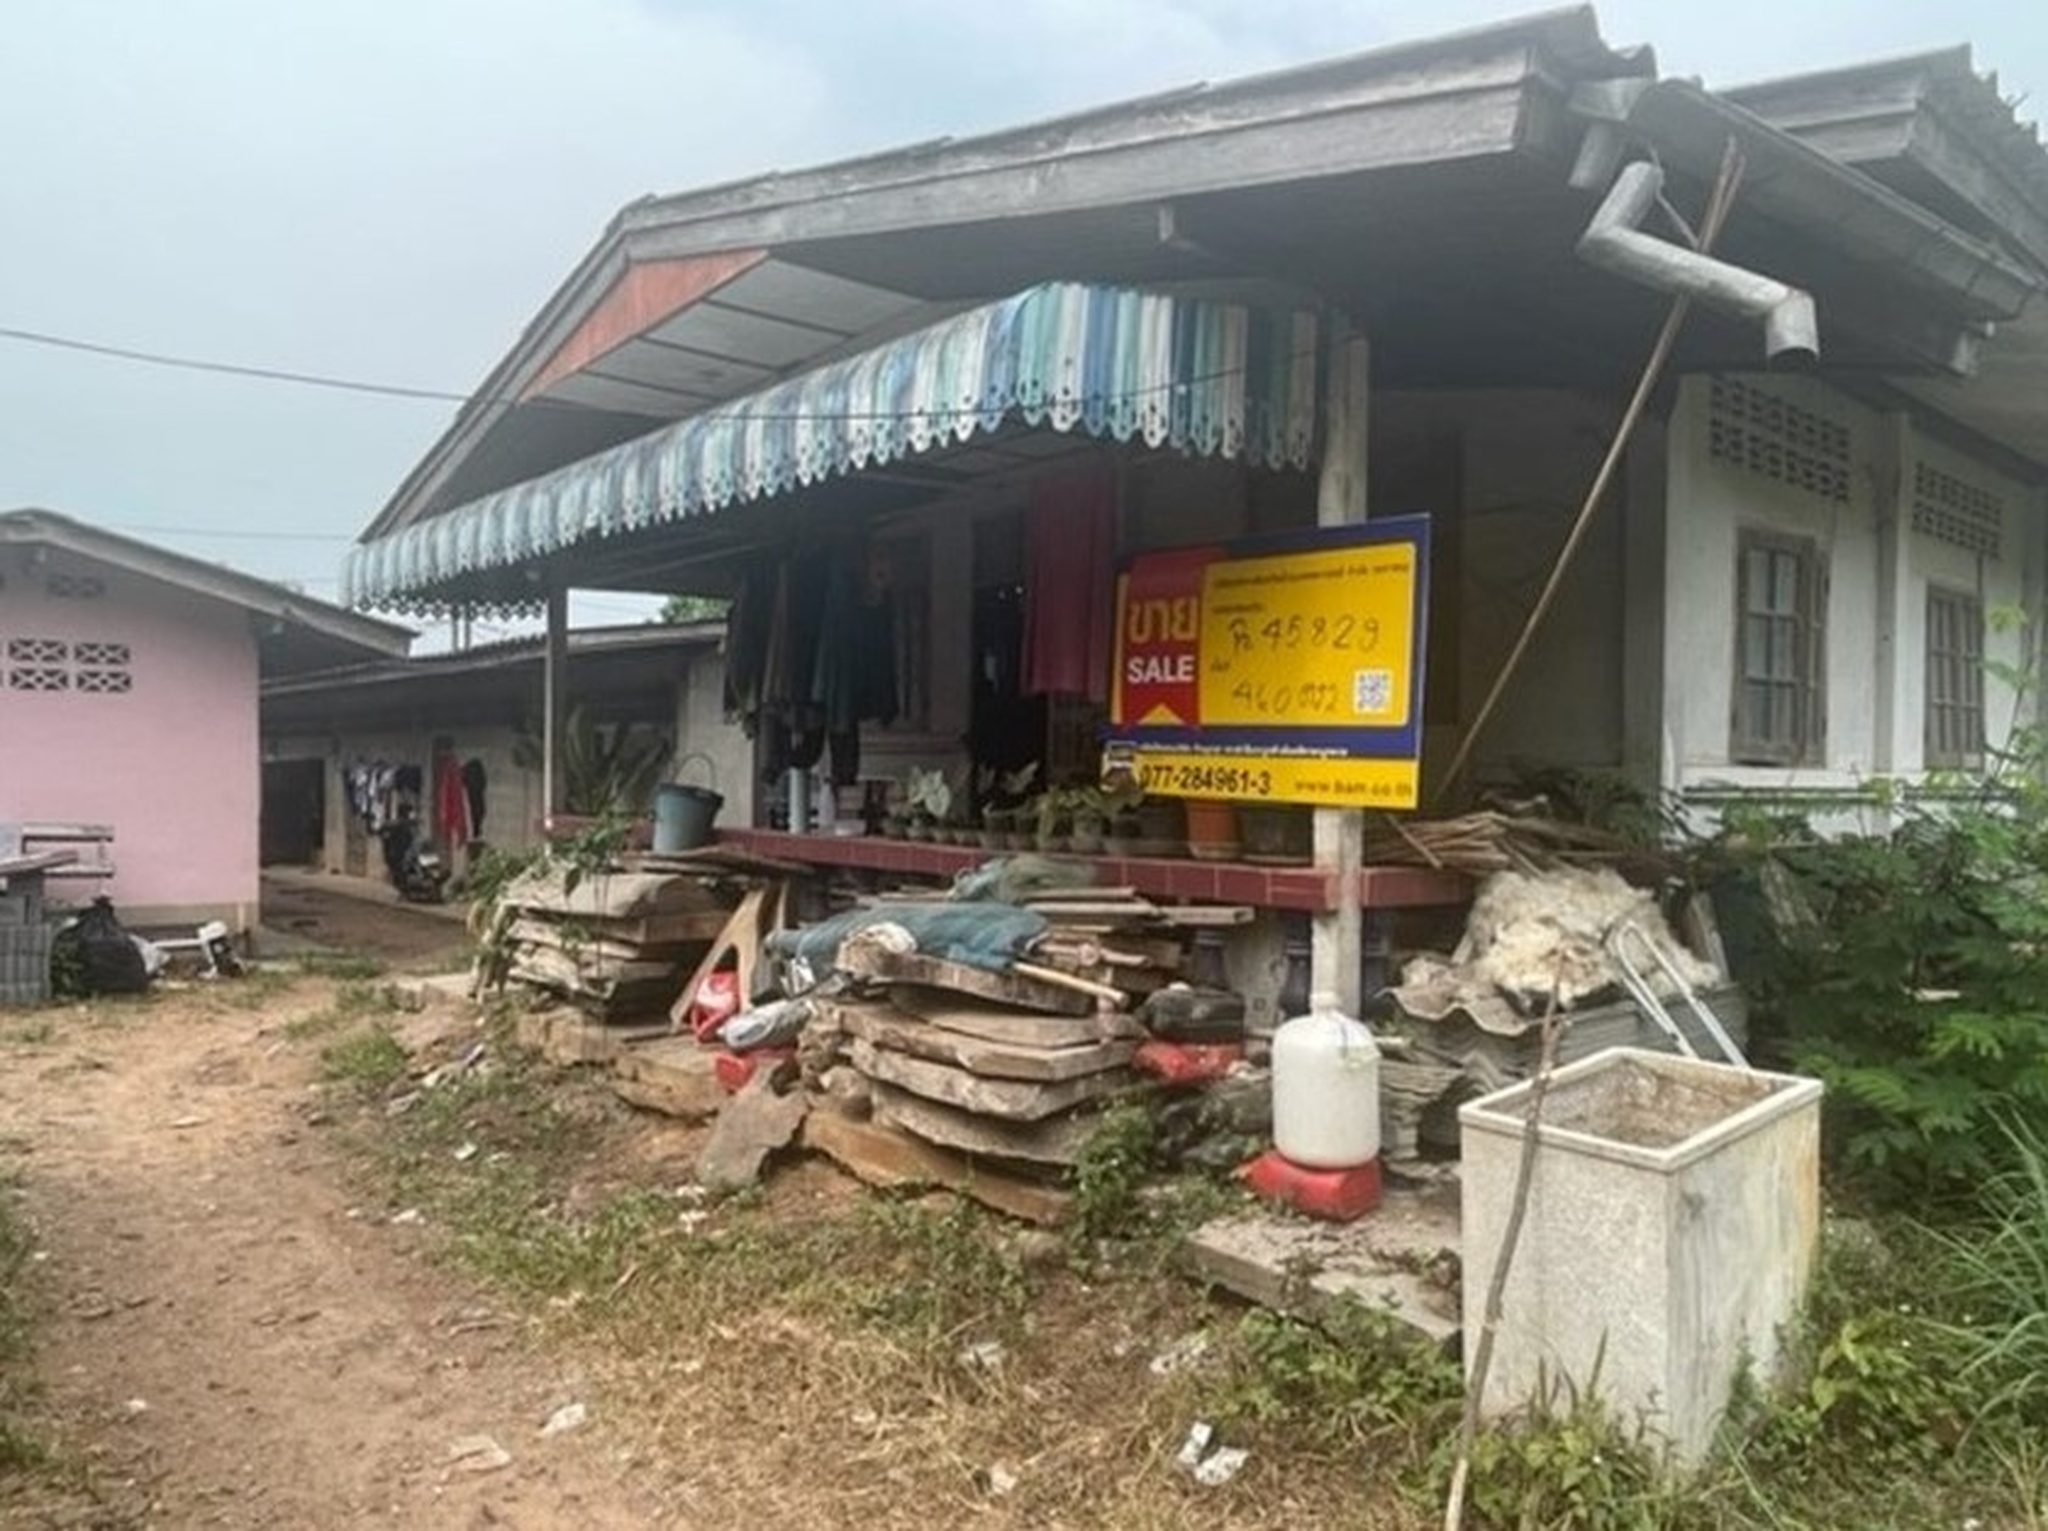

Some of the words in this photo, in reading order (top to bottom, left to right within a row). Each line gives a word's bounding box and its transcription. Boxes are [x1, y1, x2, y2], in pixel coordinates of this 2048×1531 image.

[1128, 596, 1198, 644] ขาย
[1126, 654, 1196, 684] SALE
[1140, 764, 1271, 796] 077-284961-3
